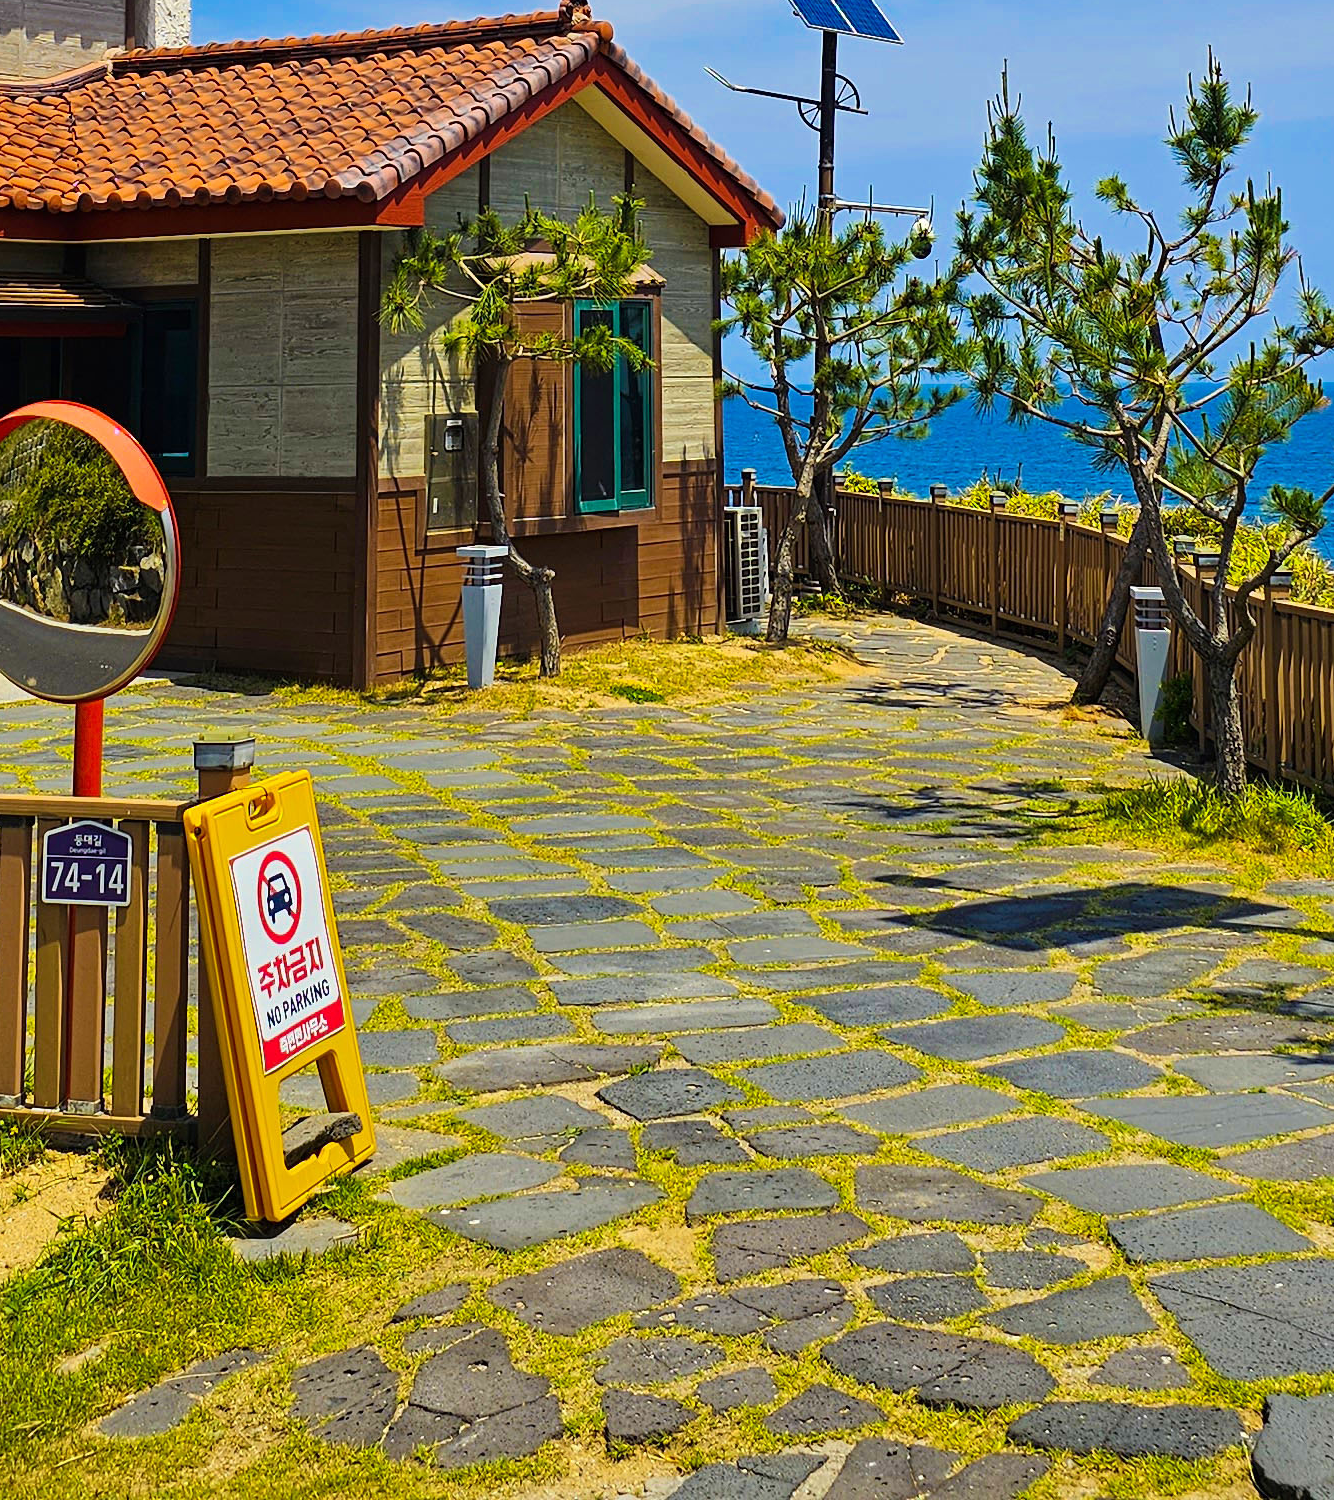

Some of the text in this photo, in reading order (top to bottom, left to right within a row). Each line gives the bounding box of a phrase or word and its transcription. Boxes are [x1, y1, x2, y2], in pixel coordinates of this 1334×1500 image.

[69, 846, 107, 856] Deungdae-gil
[73, 834, 103, 847] 등대길
[50, 861, 124, 895] 74-14
[258, 936, 324, 999] 주차금지
[266, 978, 330, 1030] NO PARKING
